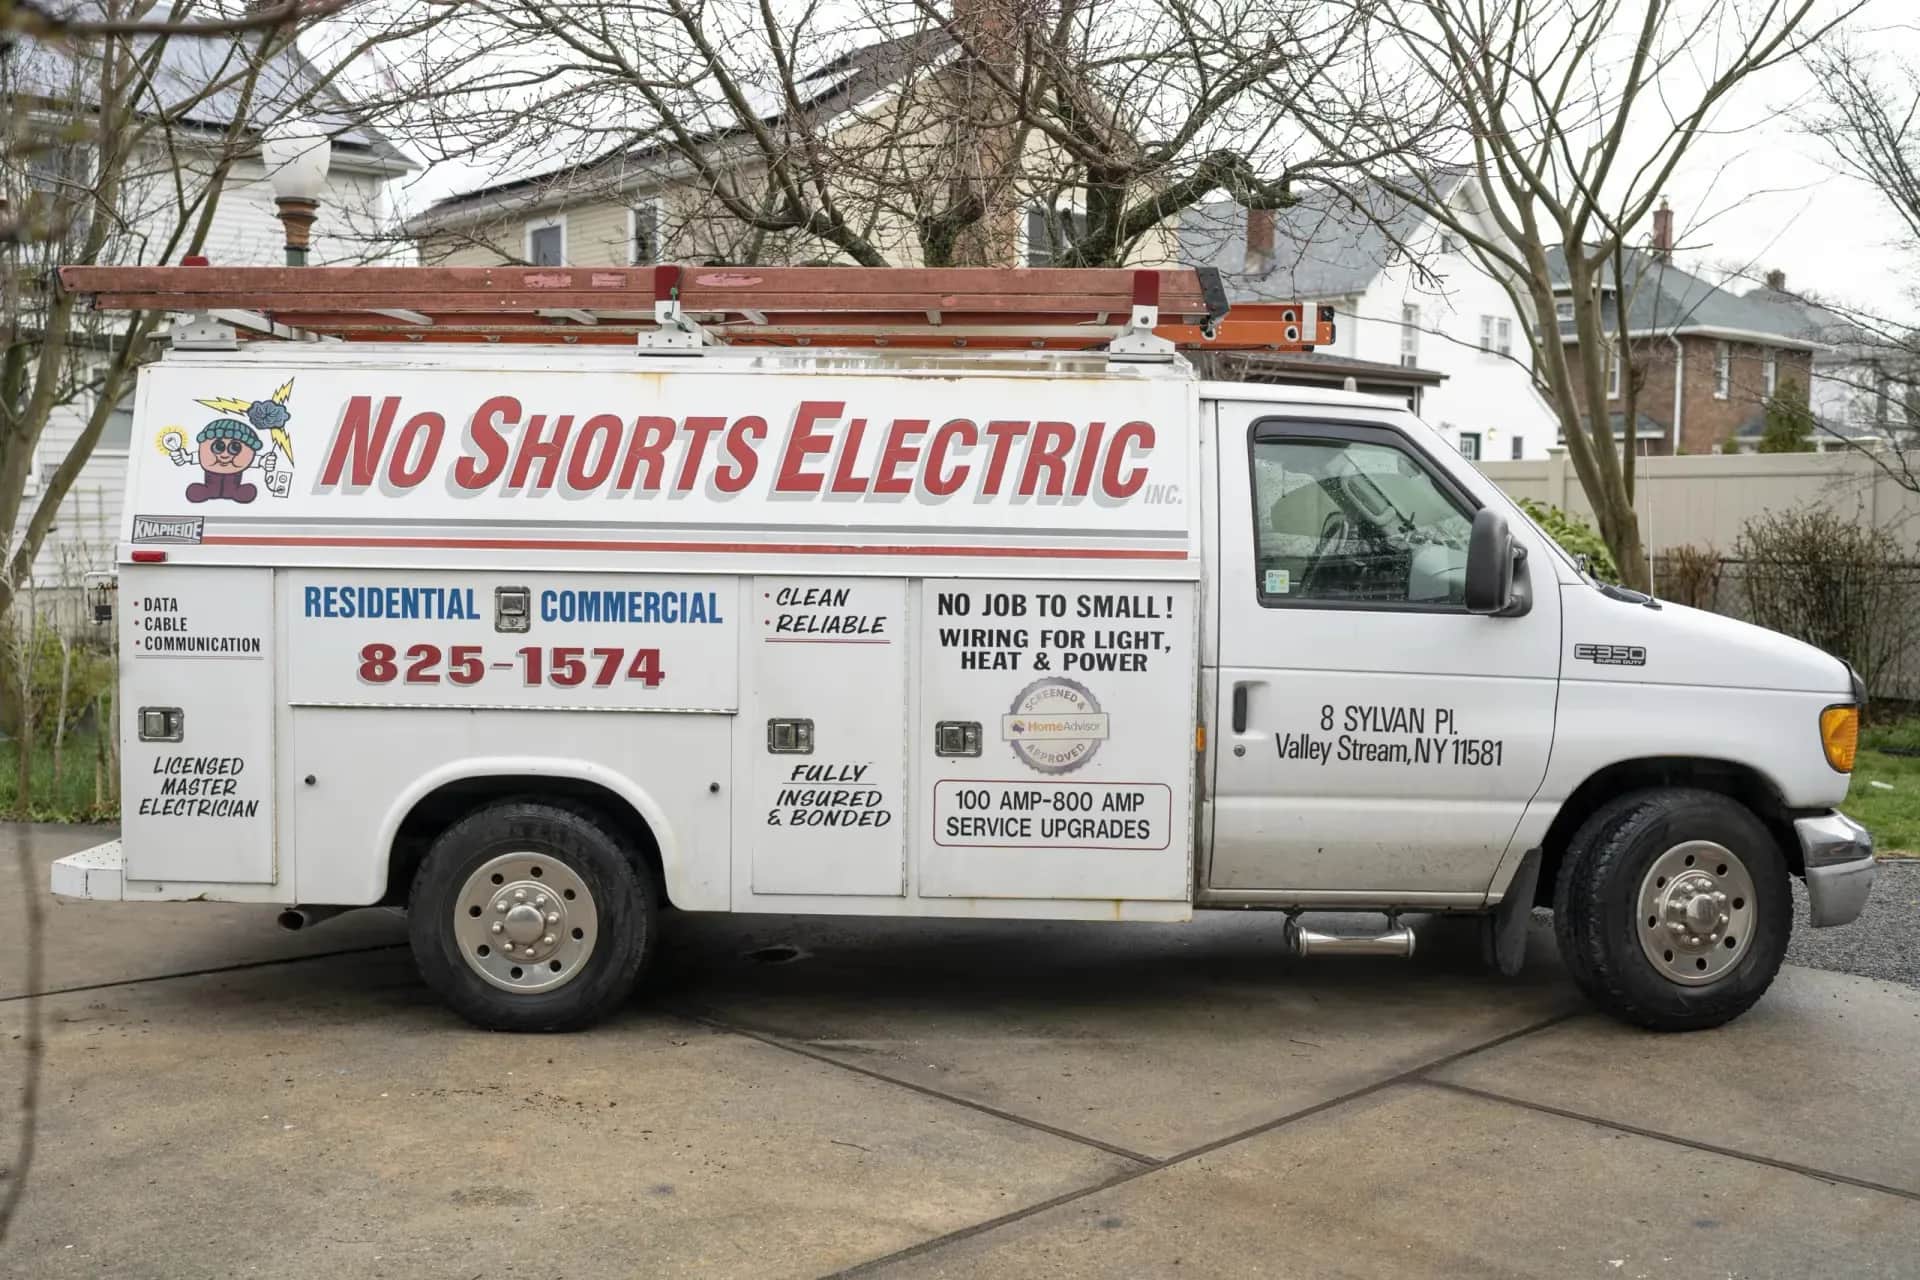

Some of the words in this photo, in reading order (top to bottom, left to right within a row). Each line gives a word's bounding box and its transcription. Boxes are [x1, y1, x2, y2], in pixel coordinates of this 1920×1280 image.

[315, 395, 446, 492] NO
[452, 395, 769, 497] SHORTS
[770, 400, 1157, 504] ELECTRIC
[1144, 483, 1183, 505] INC.
[134, 519, 203, 540] KNAPHEIDE
[143, 597, 178, 613] DATA
[304, 586, 481, 620] RESIDENTIAL
[540, 589, 723, 625] COMMERCIAL
[775, 587, 851, 608] CLEAN
[937, 593, 970, 617] NO
[982, 593, 1027, 618] JOB
[1036, 594, 1067, 618] TO
[144, 616, 188, 632] CABLE
[775, 615, 887, 635] RELIABLE
[144, 636, 261, 653] COMMUNICATION
[939, 628, 1029, 649] WIRING
[1040, 629, 1086, 650] FOR
[1094, 630, 1171, 653] LIGHT,
[358, 642, 666, 689] 825-1574
[960, 651, 1022, 671] HEAT
[1033, 652, 1051, 671] &
[1063, 652, 1149, 672] POWER
[1025, 688, 1078, 711] SCREENED
[1027, 720, 1100, 733] HomeAdvisor
[1320, 704, 1334, 731] 8
[1344, 705, 1425, 734] SYLVAN
[1026, 743, 1085, 764] APPROVED
[1275, 732, 1333, 766] Valley
[1453, 739, 1503, 766] 11581
[153, 756, 245, 776] LICENSED
[790, 764, 868, 783] FULLY
[160, 778, 238, 797] MASTER
[138, 799, 260, 818] ELECTRICIAN
[775, 790, 883, 808] INSURED
[955, 790, 991, 810] 100
[1102, 792, 1145, 813] AMP
[767, 809, 782, 827] &
[789, 810, 892, 828] BONDED
[946, 816, 1032, 838] SERVICE
[1041, 818, 1151, 840] UPGRADES
